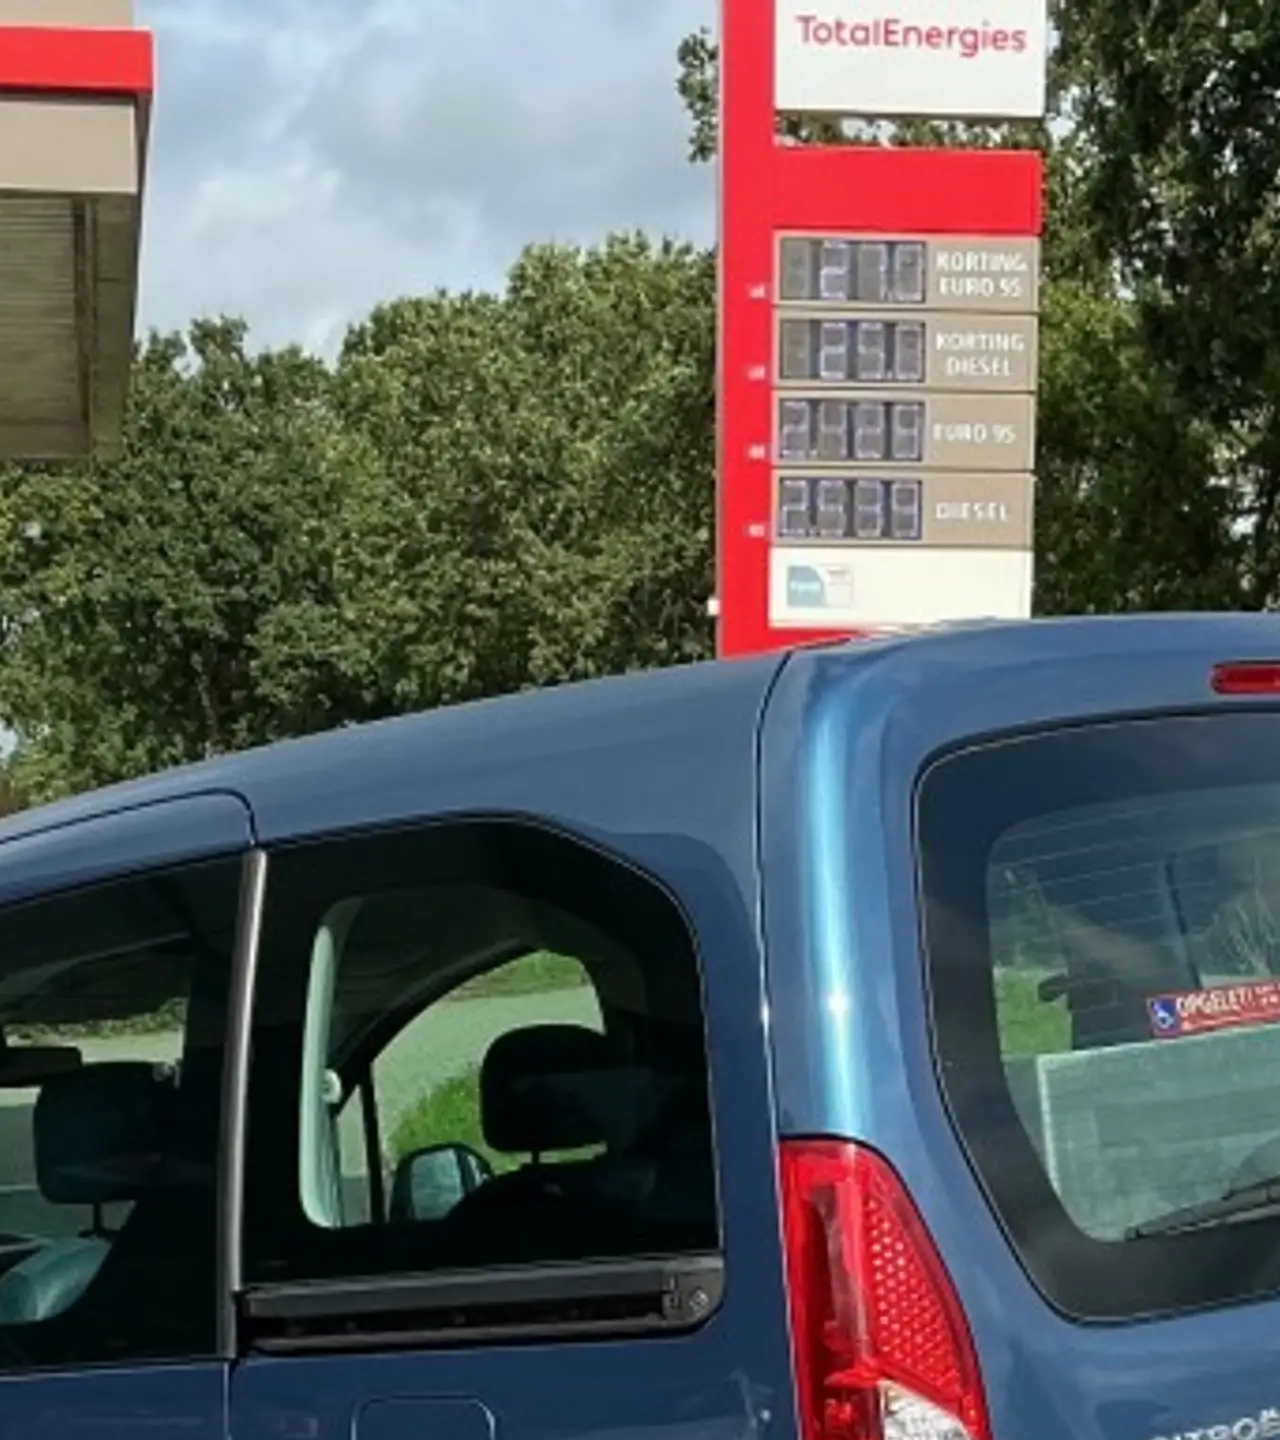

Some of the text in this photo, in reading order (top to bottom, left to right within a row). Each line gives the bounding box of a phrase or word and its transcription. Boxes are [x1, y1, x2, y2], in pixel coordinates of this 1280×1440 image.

[796, 15, 1028, 57] TotalEnergies
[935, 250, 1028, 272] KORTING
[938, 276, 994, 297] EURO
[935, 332, 1025, 351] KORTING
[946, 355, 1013, 377] DIESEL
[932, 423, 988, 443] EURO
[935, 503, 1009, 522] DIESEL
